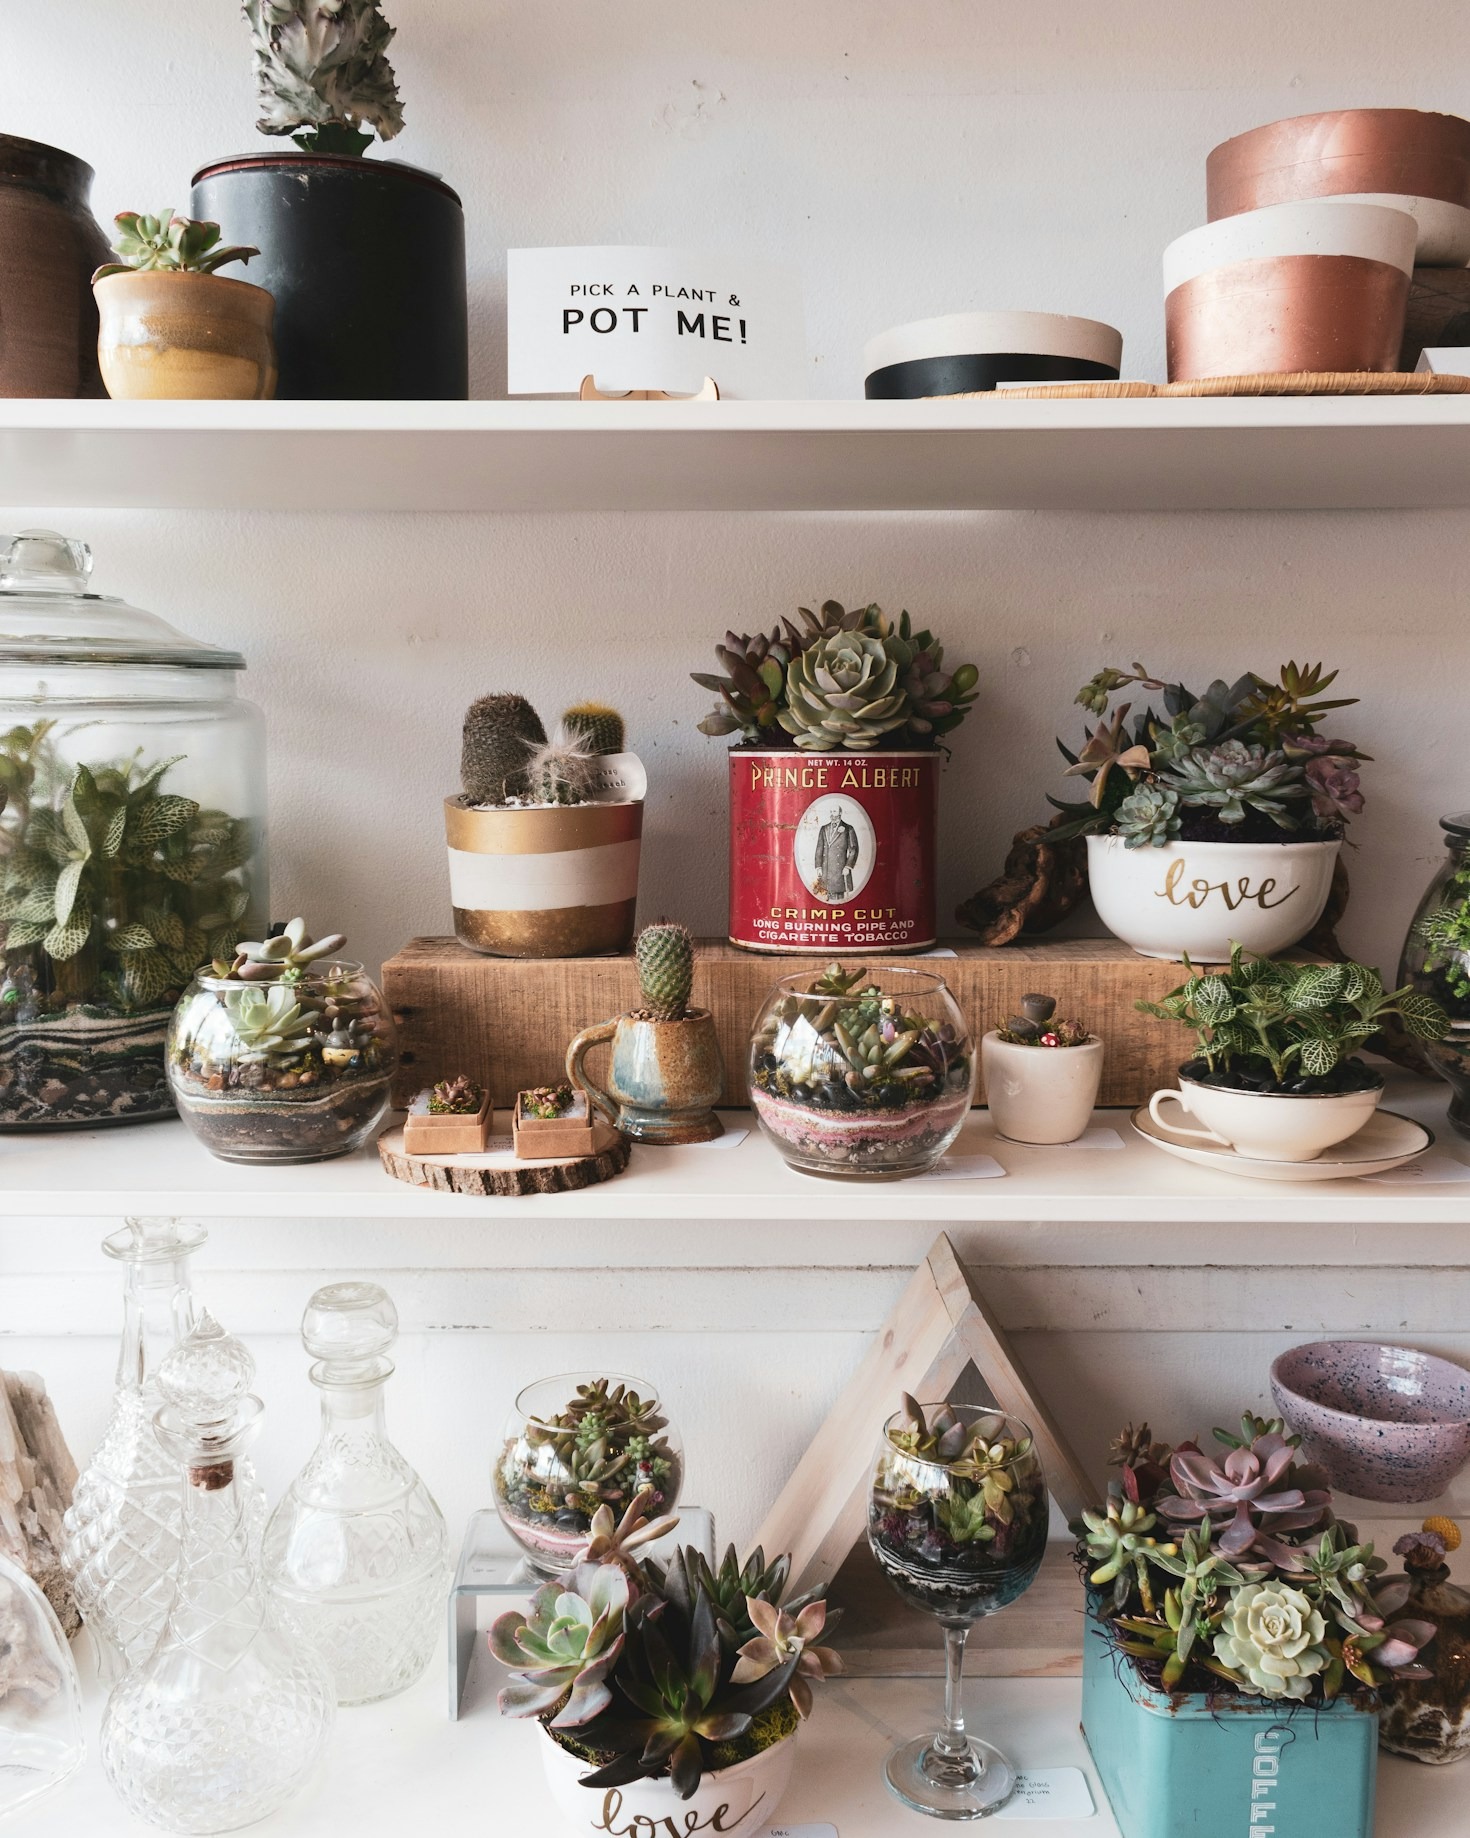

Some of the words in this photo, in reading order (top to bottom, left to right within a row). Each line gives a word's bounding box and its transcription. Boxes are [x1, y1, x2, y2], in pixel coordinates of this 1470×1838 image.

[570, 284, 614, 296] PICK
[627, 284, 640, 296] A
[652, 284, 717, 303] PLANT
[728, 294, 741, 307] &
[562, 307, 648, 334] POT
[677, 310, 747, 345] ME!
[807, 759, 823, 767] NET
[825, 759, 840, 767] WT.
[843, 759, 852, 767] 14
[854, 759, 868, 767] OZ.
[751, 761, 828, 791] PRINCE
[840, 767, 920, 788] ALBERT
[1154, 858, 1300, 911] love
[771, 907, 846, 920] CRIMP
[854, 908, 896, 920] CUT
[753, 919, 780, 930] LONG
[784, 922, 851, 932] BURNING
[857, 921, 887, 932] PIPE
[890, 920, 915, 930] AND
[758, 930, 839, 943] CIGARETTE
[844, 931, 908, 943] TOBACCO
[591, 1788, 766, 1838] love
